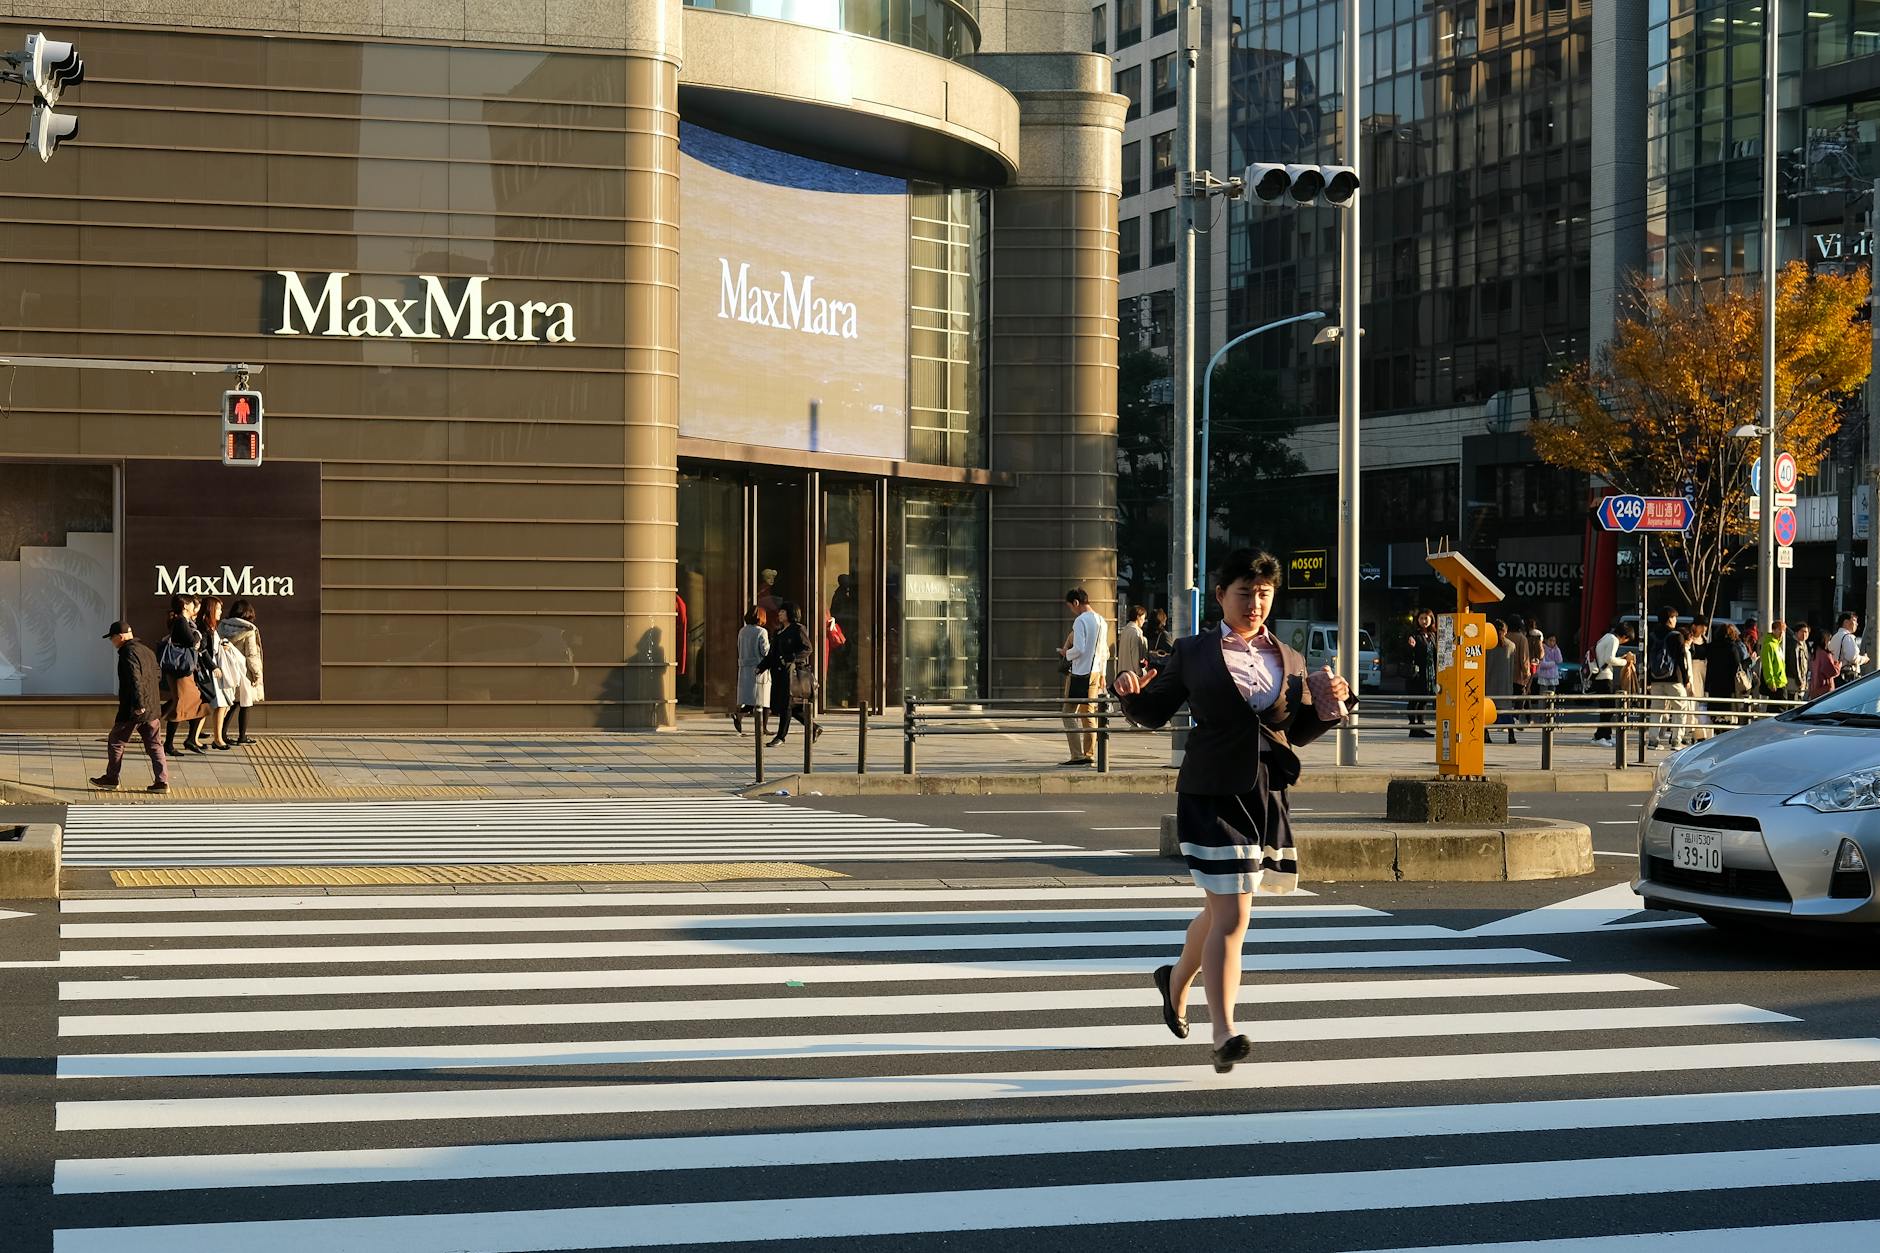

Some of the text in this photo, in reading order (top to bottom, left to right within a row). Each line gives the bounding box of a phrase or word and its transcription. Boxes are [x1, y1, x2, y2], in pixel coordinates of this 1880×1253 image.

[274, 270, 576, 343] MaxMara
[717, 257, 858, 339] MaxMara
[1780, 465, 1792, 482] 40
[1616, 500, 1641, 518] 246
[1647, 502, 1682, 518] 青山通り
[1291, 557, 1323, 569] MOSCOT
[154, 565, 294, 596] MaxMara
[1515, 581, 1571, 596] COFFEE
[1465, 645, 1482, 658] 24K
